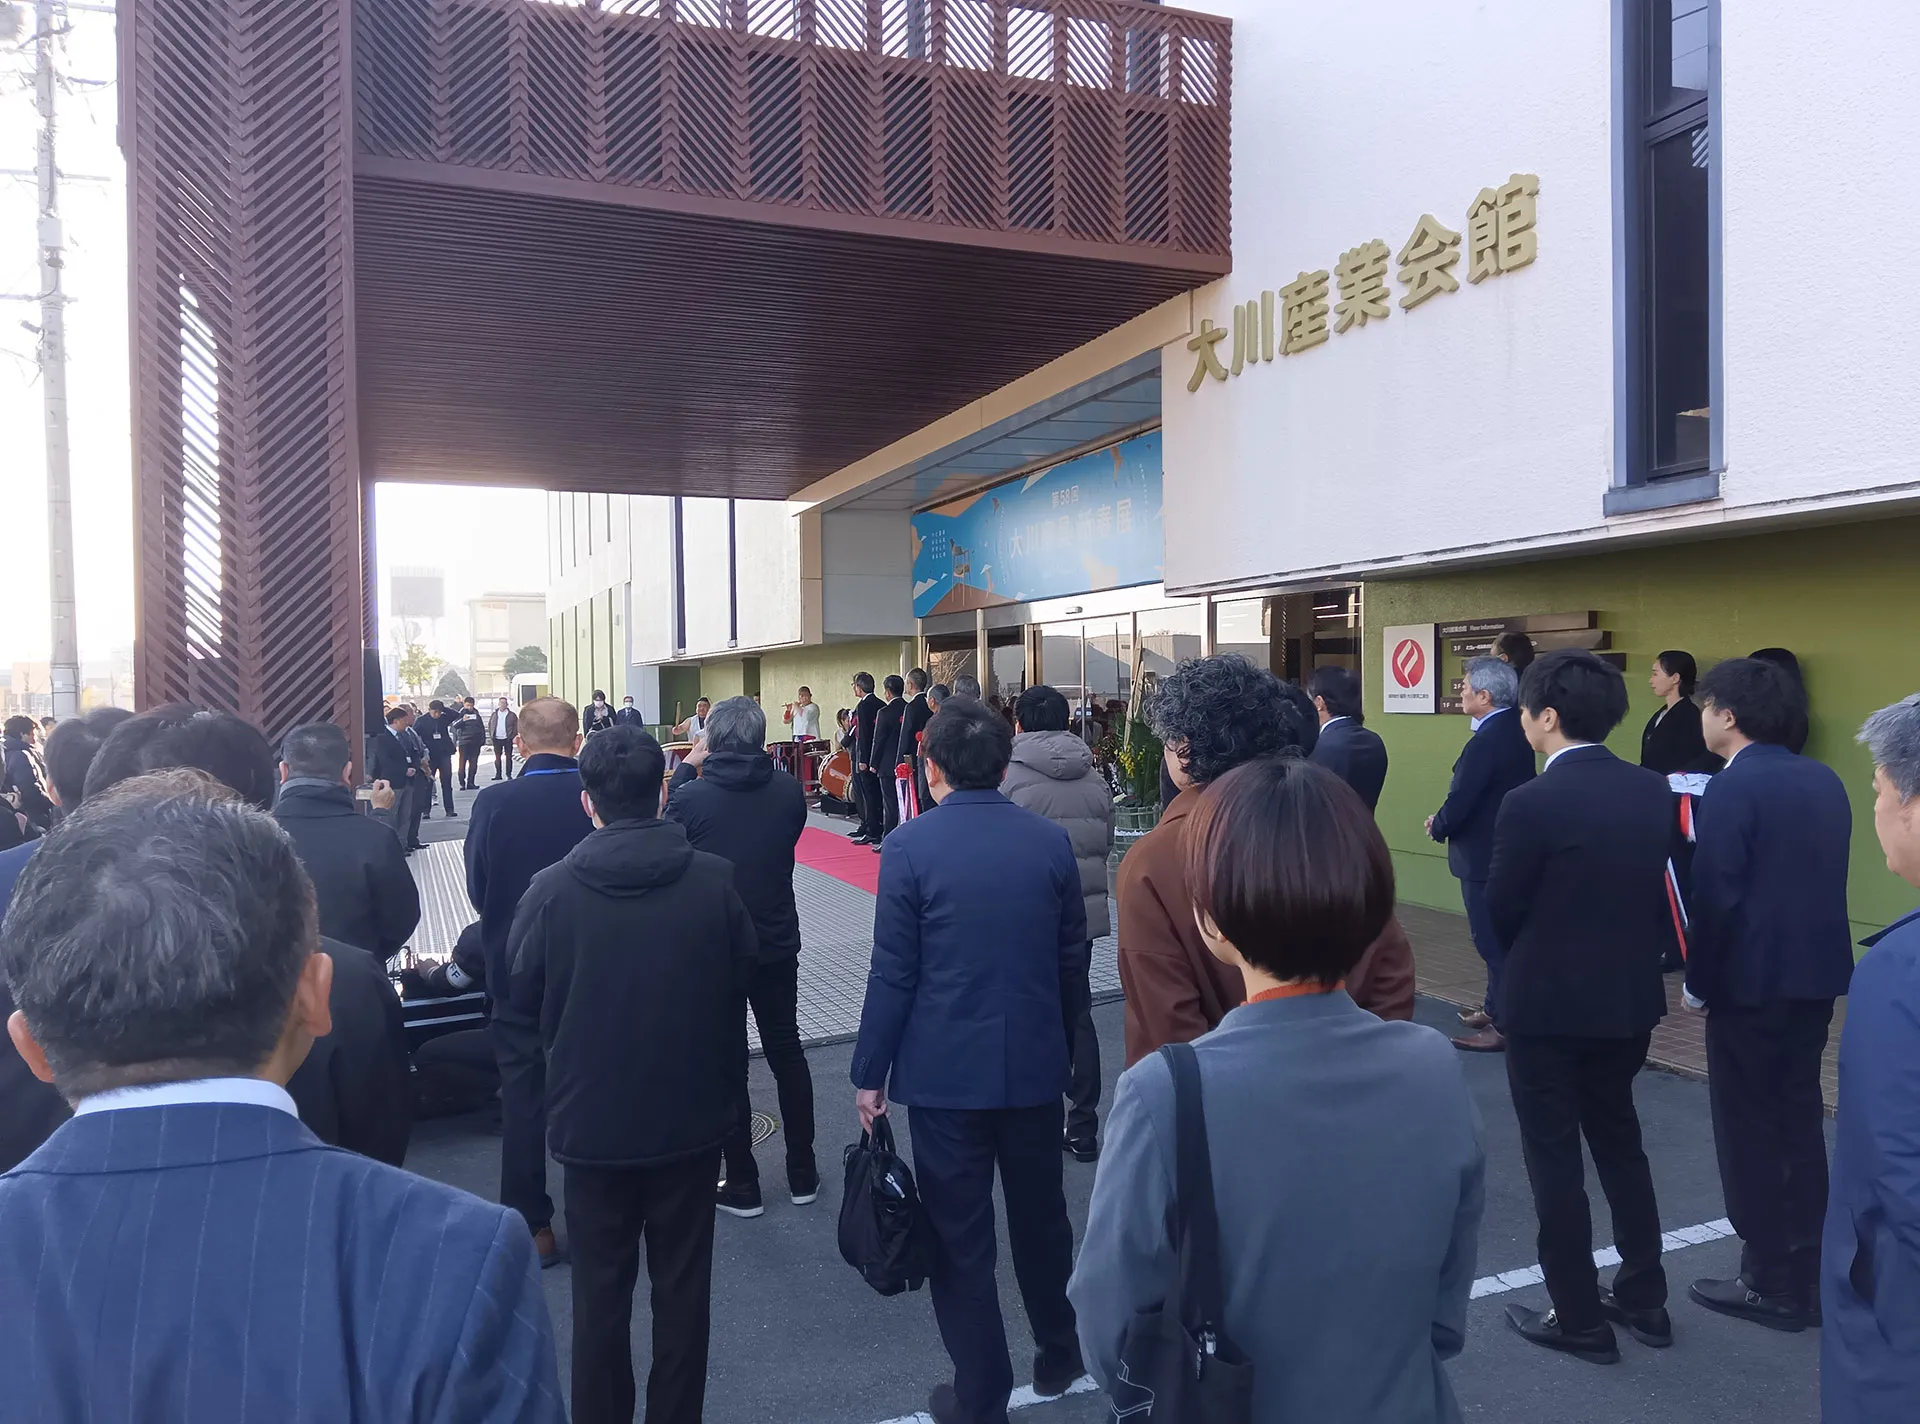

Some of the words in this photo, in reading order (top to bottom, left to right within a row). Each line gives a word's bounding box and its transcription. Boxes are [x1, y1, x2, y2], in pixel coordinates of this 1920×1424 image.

[1187, 173, 1539, 393] 大川産業会館
[1052, 485, 1080, 508] 第58回
